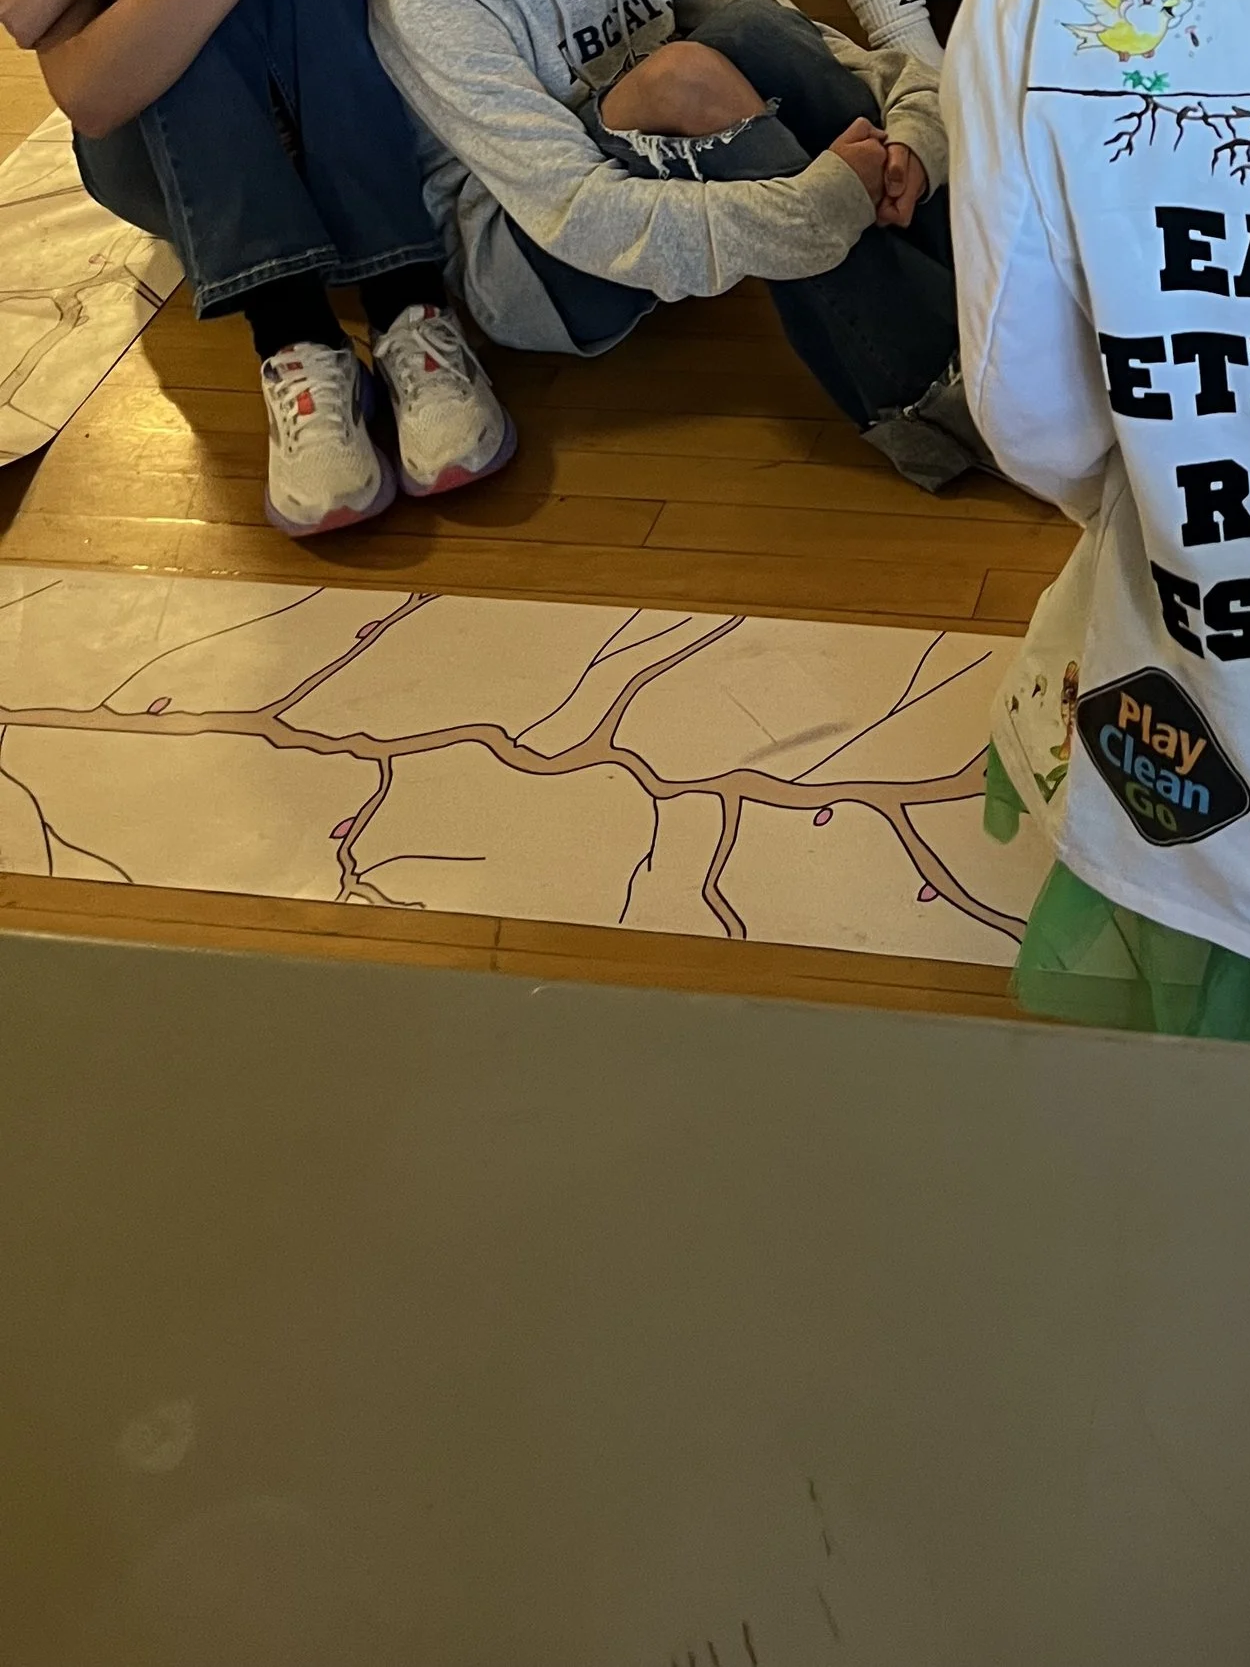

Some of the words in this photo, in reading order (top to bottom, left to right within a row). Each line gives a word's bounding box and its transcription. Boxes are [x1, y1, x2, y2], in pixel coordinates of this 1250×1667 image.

[1099, 723, 1210, 815] Clean
[1118, 690, 1207, 776] Play
[1125, 781, 1178, 832] Go
